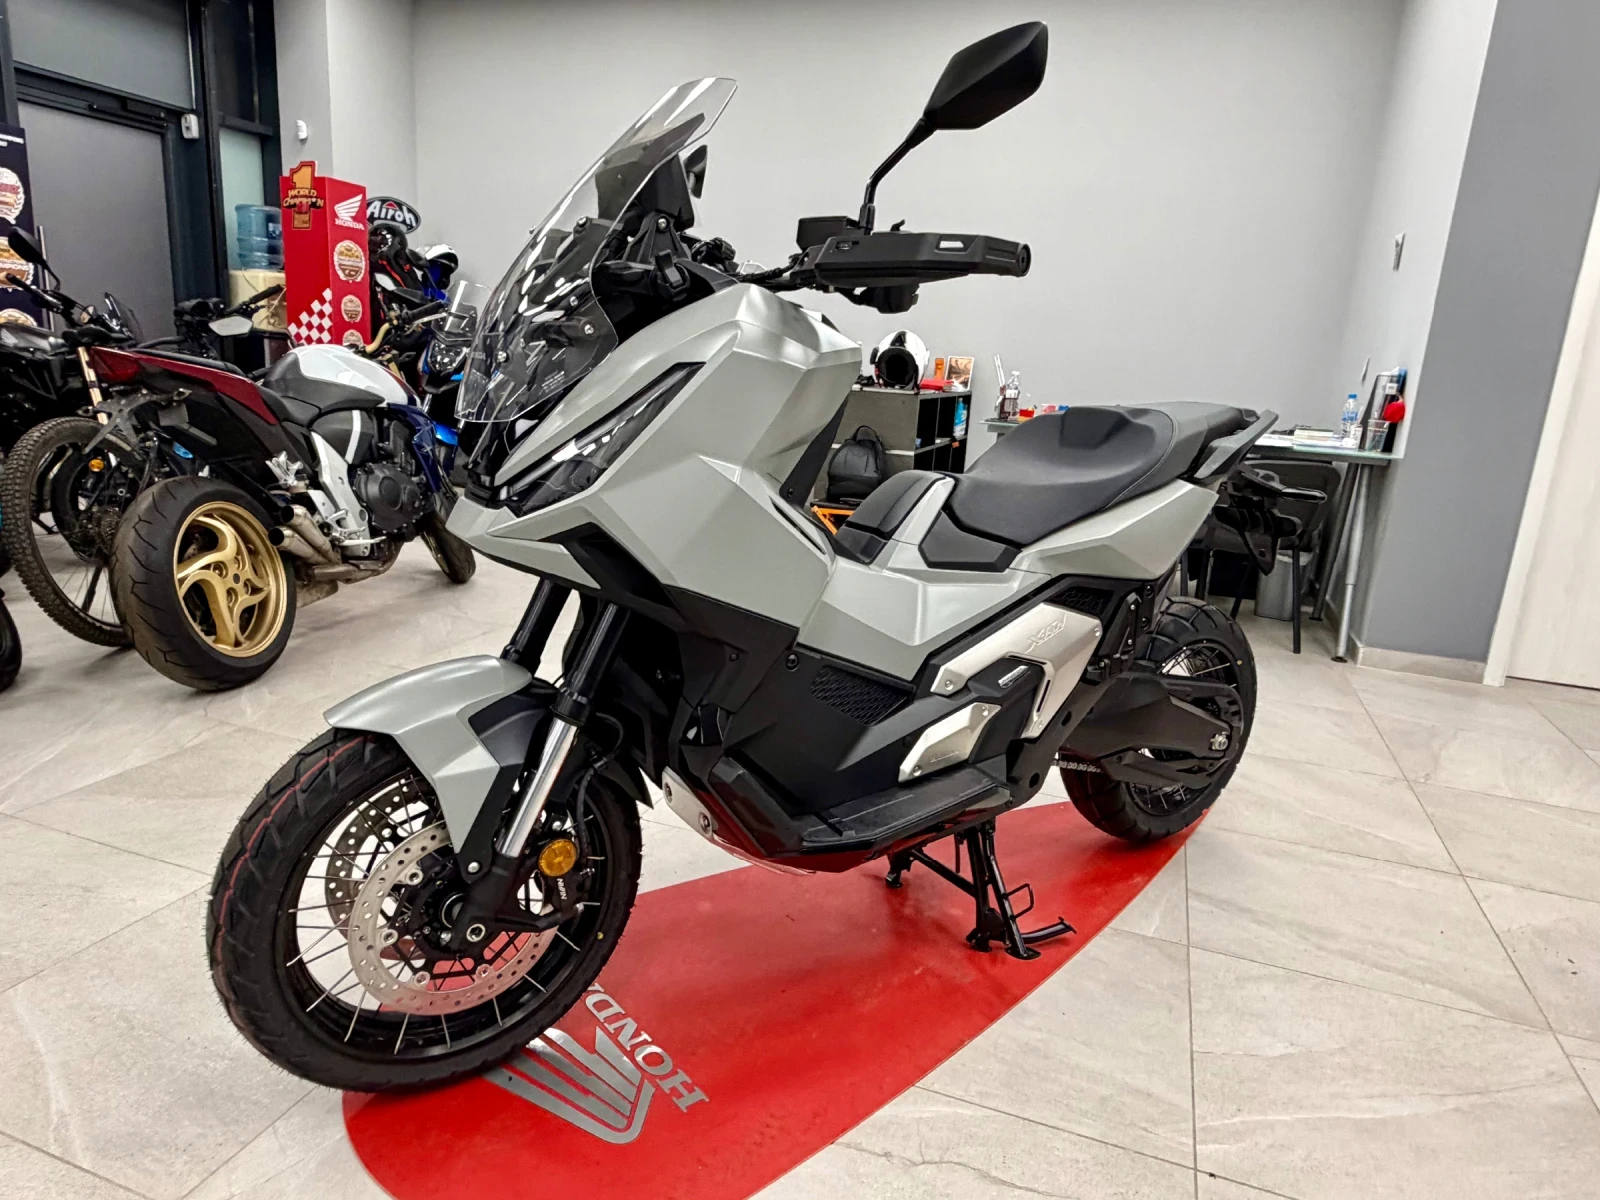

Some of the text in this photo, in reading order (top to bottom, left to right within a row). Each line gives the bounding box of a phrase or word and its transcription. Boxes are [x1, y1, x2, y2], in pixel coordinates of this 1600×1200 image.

[288, 188, 317, 198] WORLD
[366, 200, 416, 227] Airoh
[334, 218, 364, 231] HONDA
[585, 983, 709, 1112] HOND
